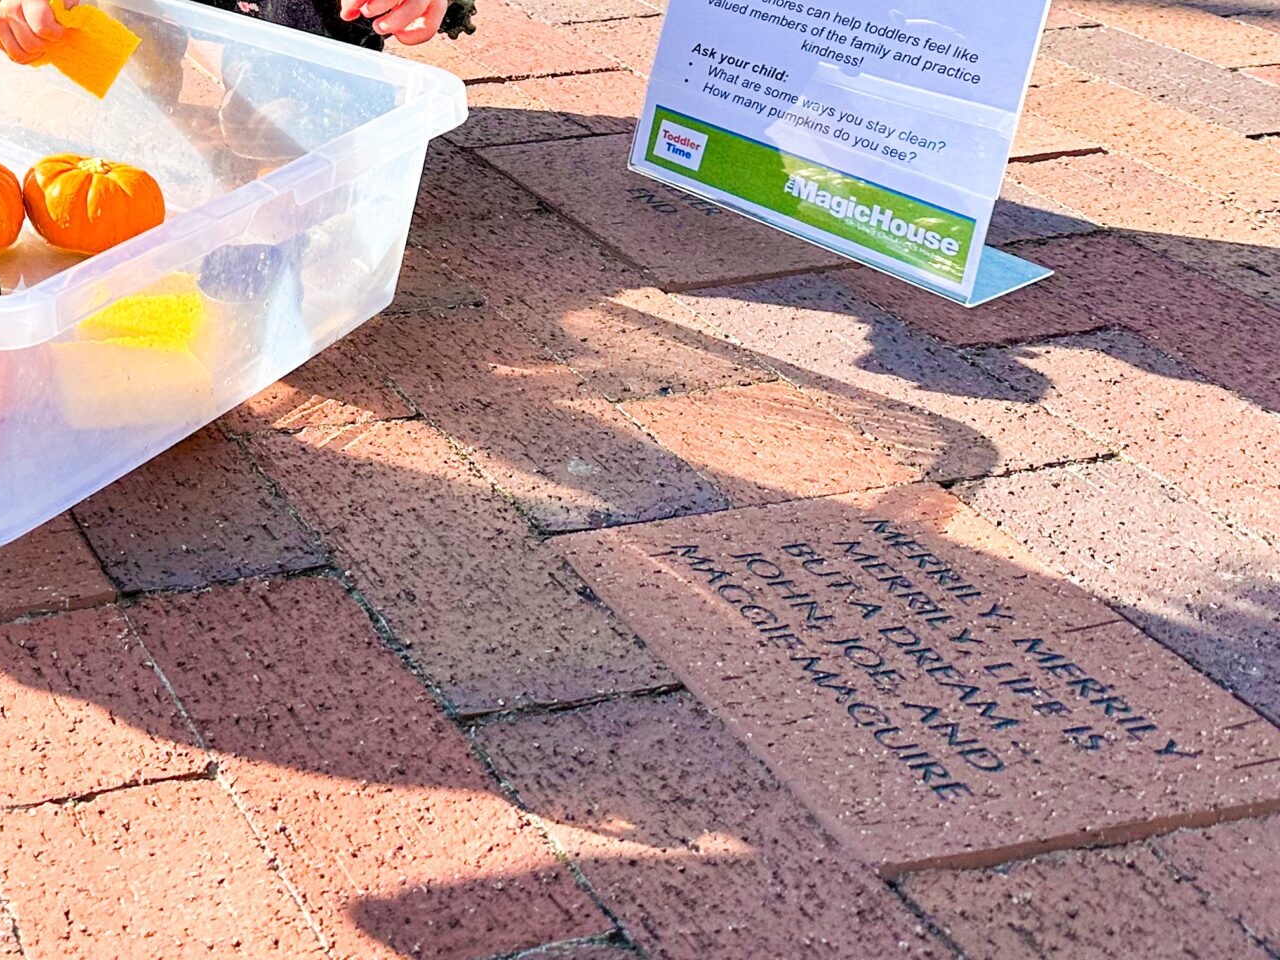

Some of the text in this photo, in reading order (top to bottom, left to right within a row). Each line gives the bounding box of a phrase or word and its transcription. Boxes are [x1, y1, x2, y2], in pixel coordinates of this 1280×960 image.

[691, 42, 790, 83] Ask your child:
[749, 8, 808, 33] members
[810, 26, 825, 38] of
[825, 29, 848, 44] the
[850, 35, 891, 59] family
[892, 51, 922, 67] and
[922, 59, 981, 85] practice
[800, 39, 865, 68] kindness!
[806, 6, 831, 21] can
[832, 12, 862, 31] help
[864, 21, 921, 47] toddlers
[923, 37, 951, 56] feel
[952, 46, 979, 63] like
[663, 129, 702, 151] Toddler
[702, 81, 918, 164] How many pumpkins do you see?
[707, 64, 946, 153] What are some ways you stay clean?
[666, 142, 692, 159] Time
[625, 187, 678, 214] END
[792, 175, 960, 256] MagicHouse
[781, 542, 863, 591] BUT
[846, 601, 882, 621] A
[670, 544, 976, 801] MAGGIE MAGUIRE
[983, 661, 1073, 718] LIFE
[1062, 725, 1112, 751] IS
[1011, 637, 1204, 759] MERRILY
[901, 701, 1006, 773] AND
